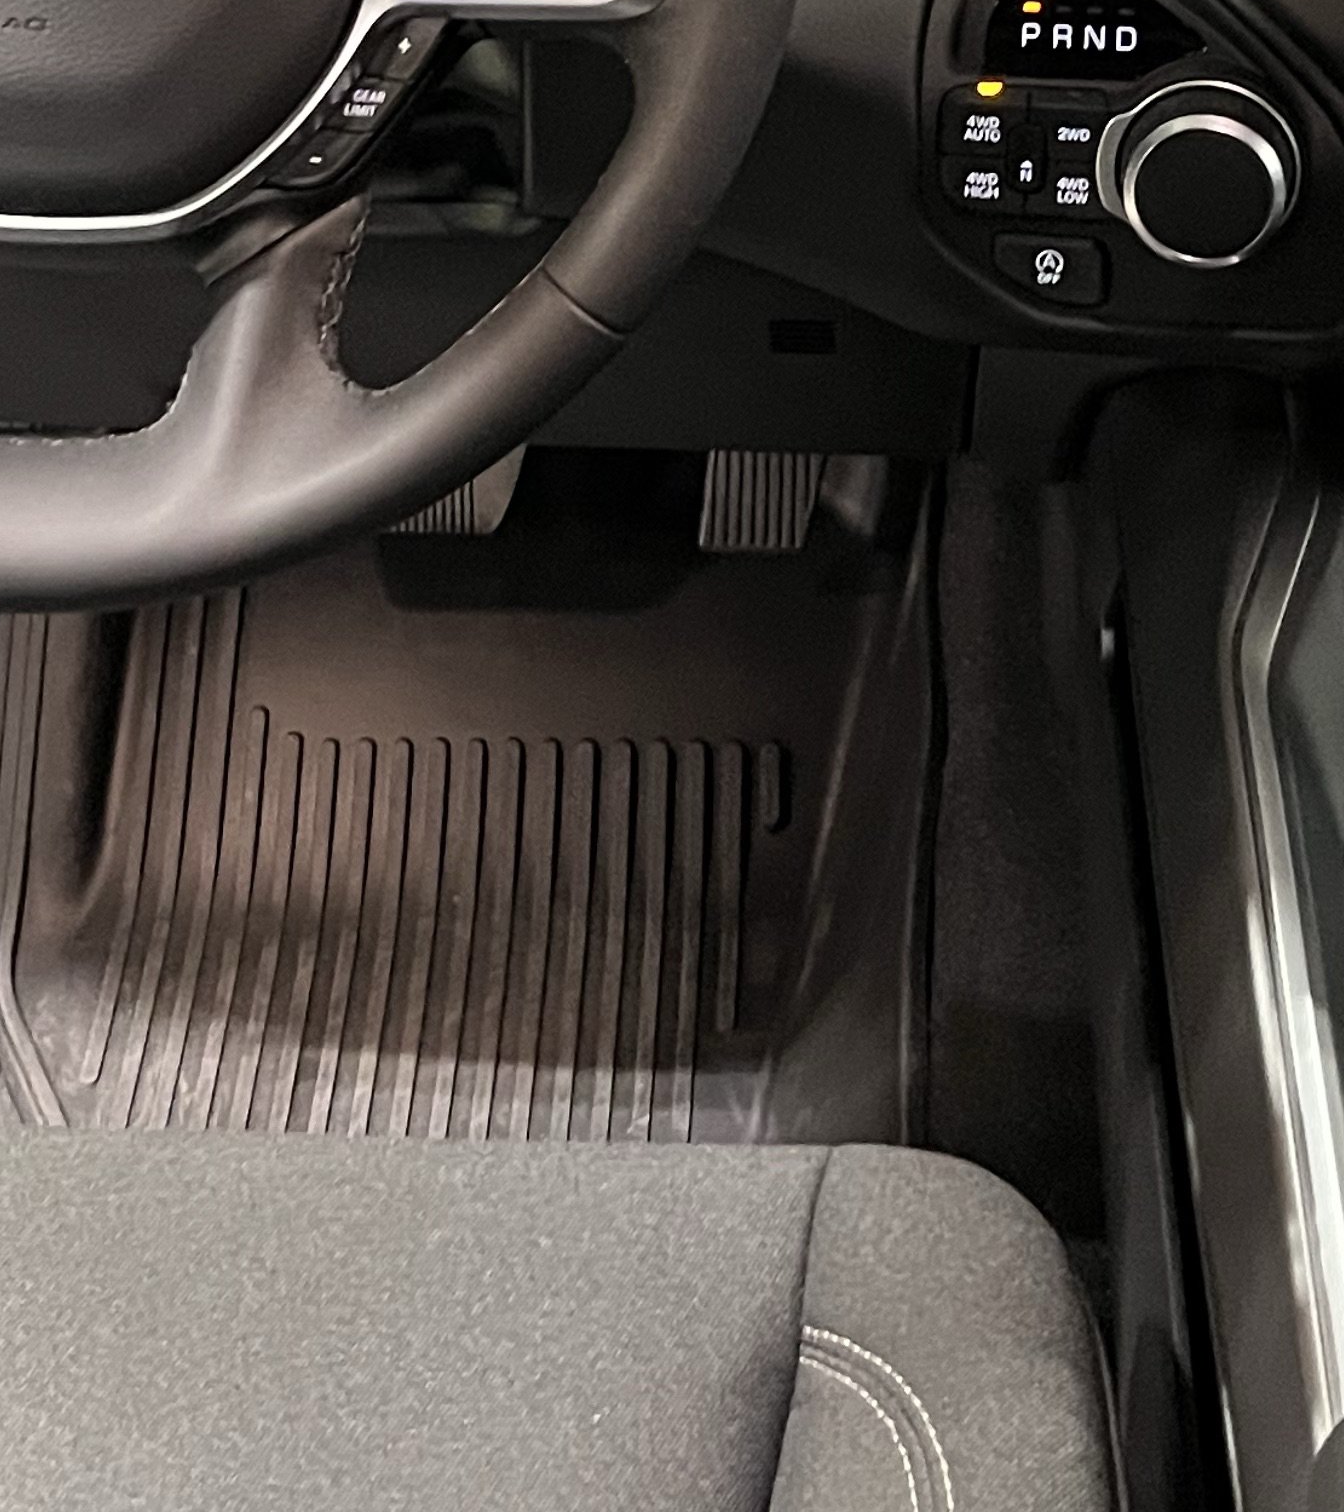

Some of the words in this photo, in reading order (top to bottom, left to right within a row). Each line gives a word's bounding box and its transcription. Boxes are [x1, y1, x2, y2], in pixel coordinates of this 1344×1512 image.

[1021, 23, 1040, 47] P
[1053, 24, 1072, 49] R
[1083, 25, 1106, 51] N
[1116, 26, 1137, 52] D
[966, 115, 1000, 130] 4WD
[964, 128, 1001, 143] AUTO
[1058, 127, 1090, 142] 2WD
[966, 172, 999, 186] 4WD
[1057, 177, 1089, 191] 4WD
[964, 185, 999, 200] HIGH
[1057, 190, 1089, 205] LOW
